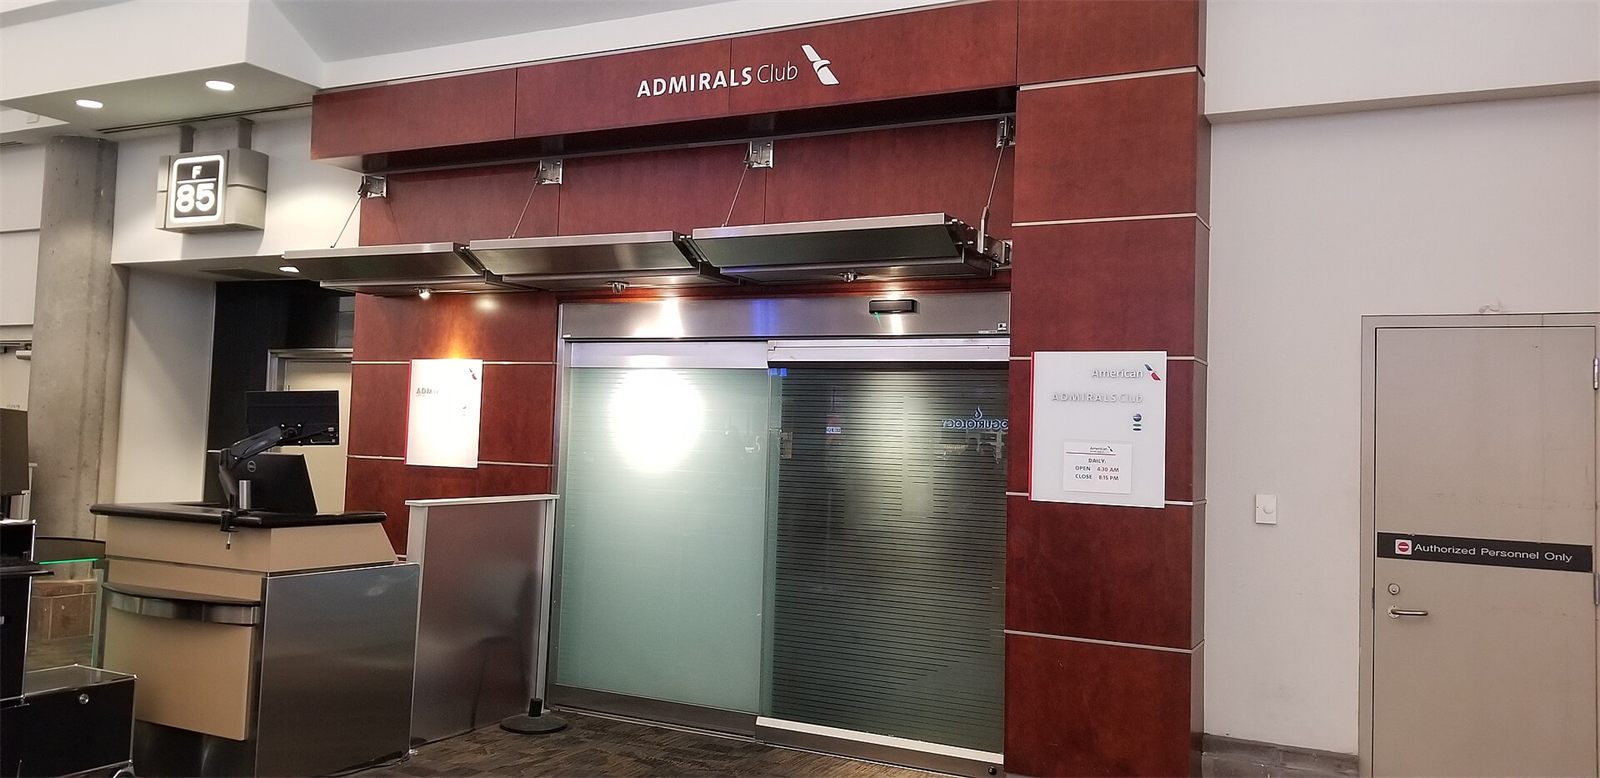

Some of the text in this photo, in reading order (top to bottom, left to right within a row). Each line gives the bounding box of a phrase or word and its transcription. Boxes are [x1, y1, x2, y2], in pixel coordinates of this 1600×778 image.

[636, 61, 798, 98] ADMIRALS Club
[191, 165, 203, 180] F
[175, 182, 216, 213] 85
[1091, 368, 1143, 379] American
[1051, 391, 1144, 404] ADMIRALS Club
[1414, 543, 1573, 564] Authorized Personnel Only
